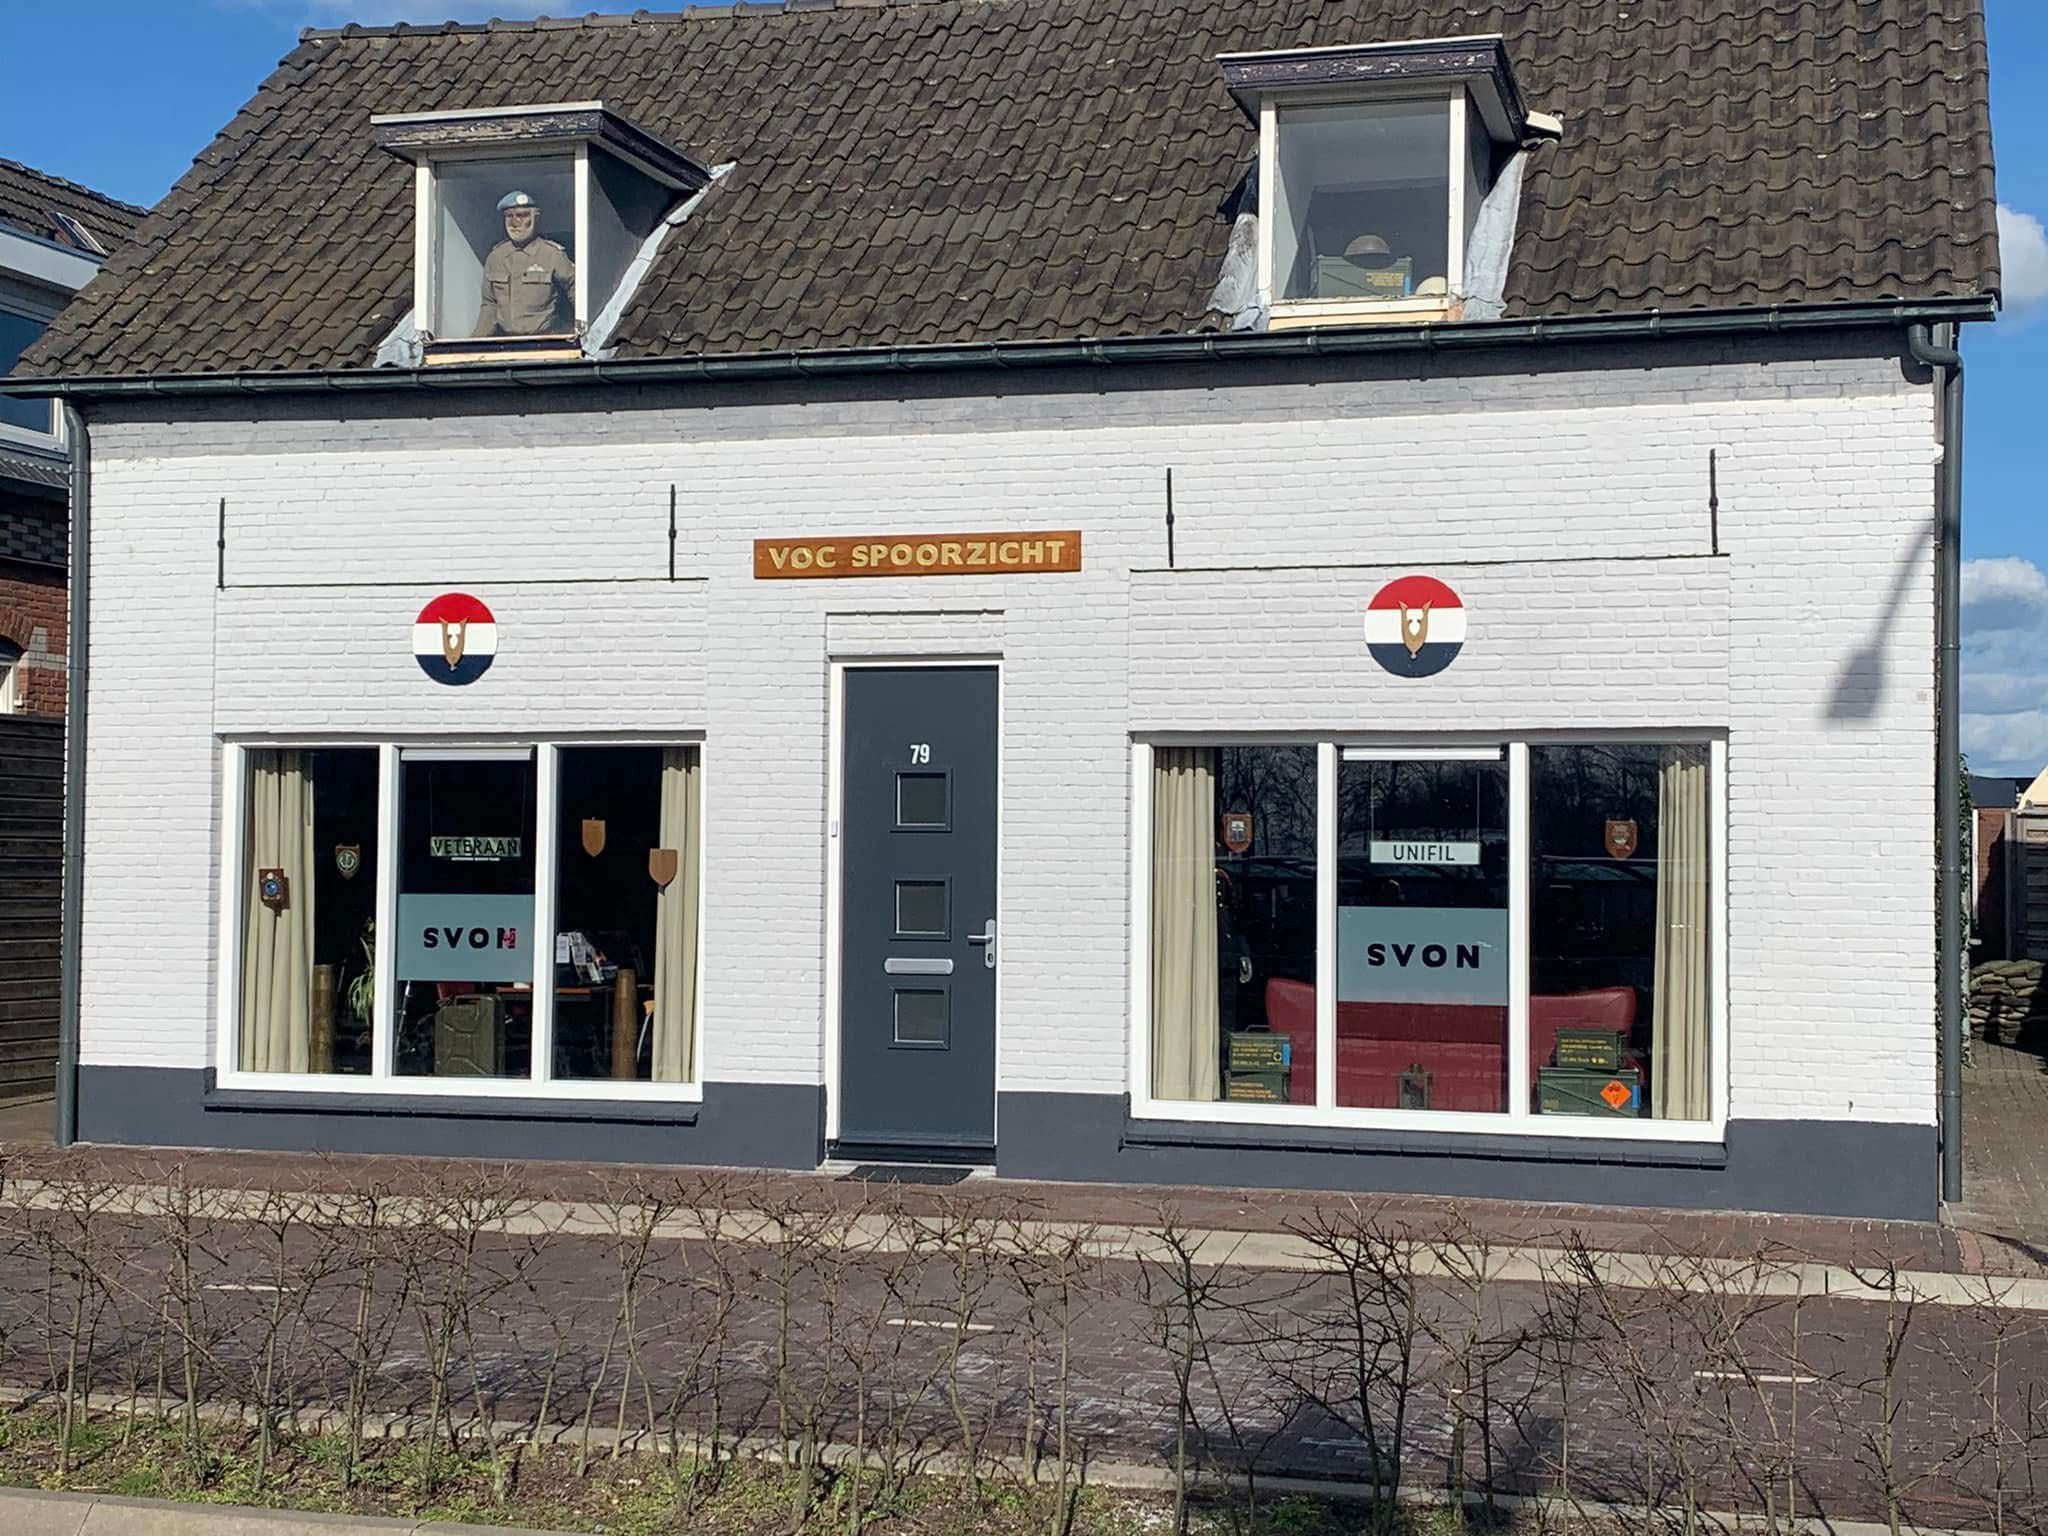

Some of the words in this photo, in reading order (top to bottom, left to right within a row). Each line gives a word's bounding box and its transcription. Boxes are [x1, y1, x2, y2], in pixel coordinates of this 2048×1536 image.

[768, 545, 837, 570] VOC
[851, 540, 1066, 568] SPOORZICHT
[910, 743, 930, 765] 79
[1393, 844, 1456, 861] UNIFIL
[423, 927, 517, 949] SVON
[1367, 943, 1480, 969] SVON
